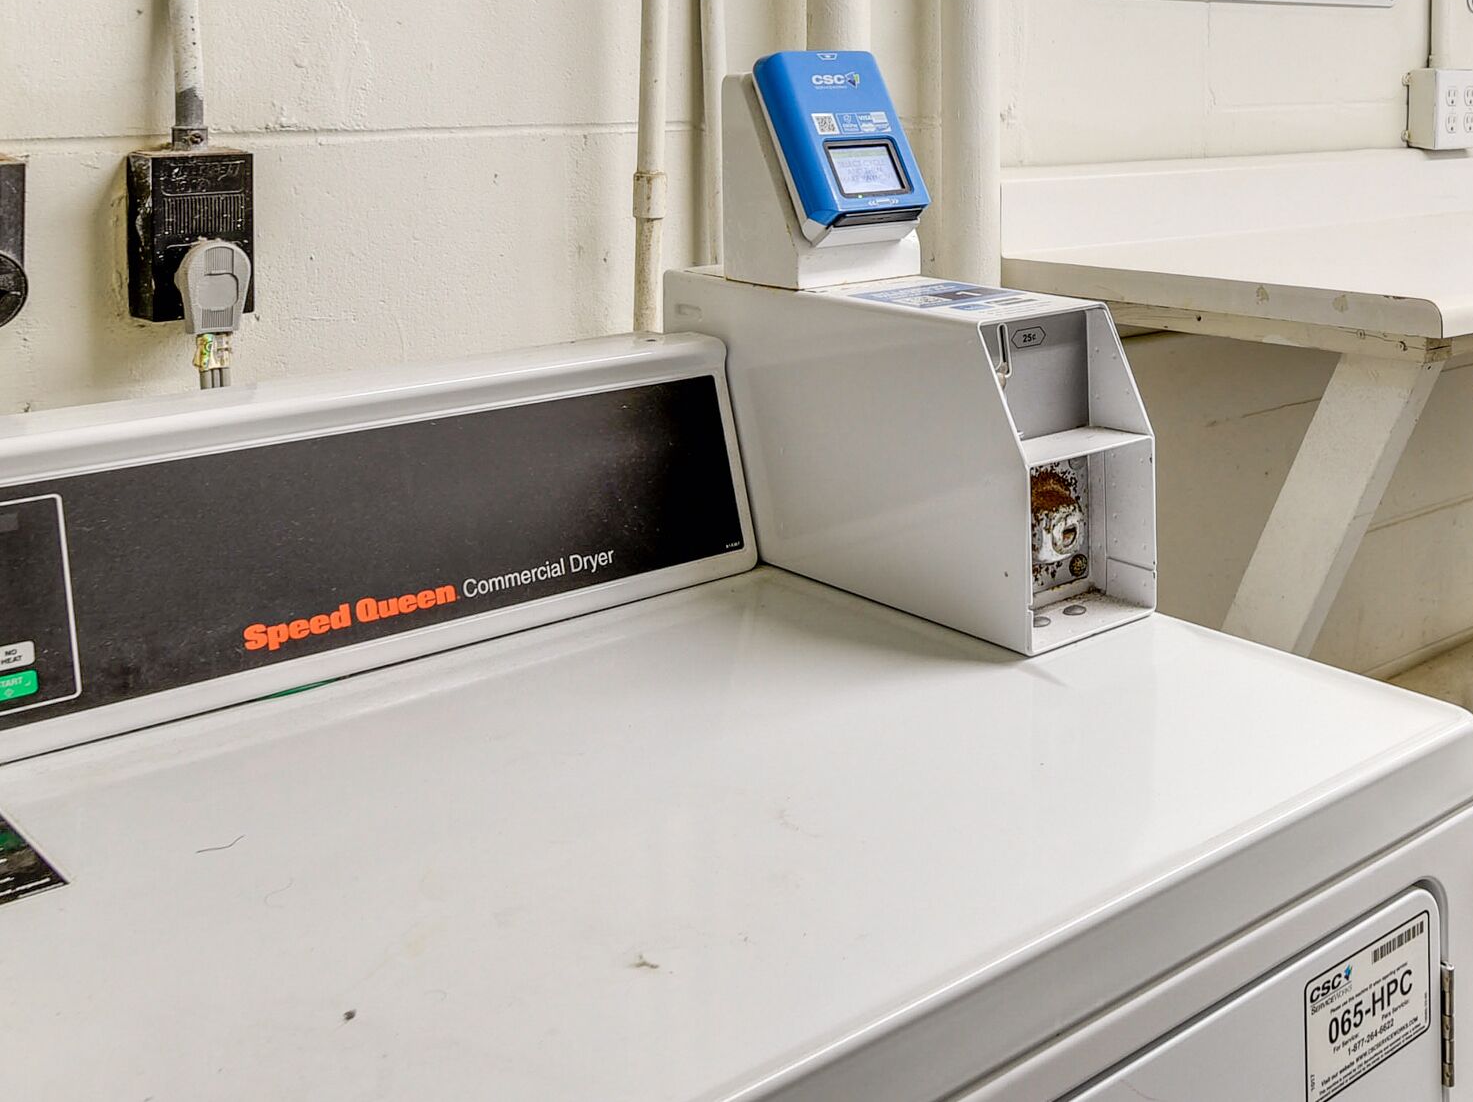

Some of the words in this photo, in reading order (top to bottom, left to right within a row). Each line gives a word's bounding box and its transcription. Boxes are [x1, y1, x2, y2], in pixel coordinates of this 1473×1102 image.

[811, 74, 846, 86] CSC
[1022, 332, 1037, 343] 25¢
[242, 603, 352, 651] Speed
[355, 583, 458, 623] Queen
[463, 558, 566, 599] Commercial
[569, 548, 614, 573] Dryer
[5, 648, 18, 656] NO
[0, 655, 23, 666] HEAT
[1310, 973, 1342, 1004] CSC
[1328, 969, 1413, 1044] 065-HPC
